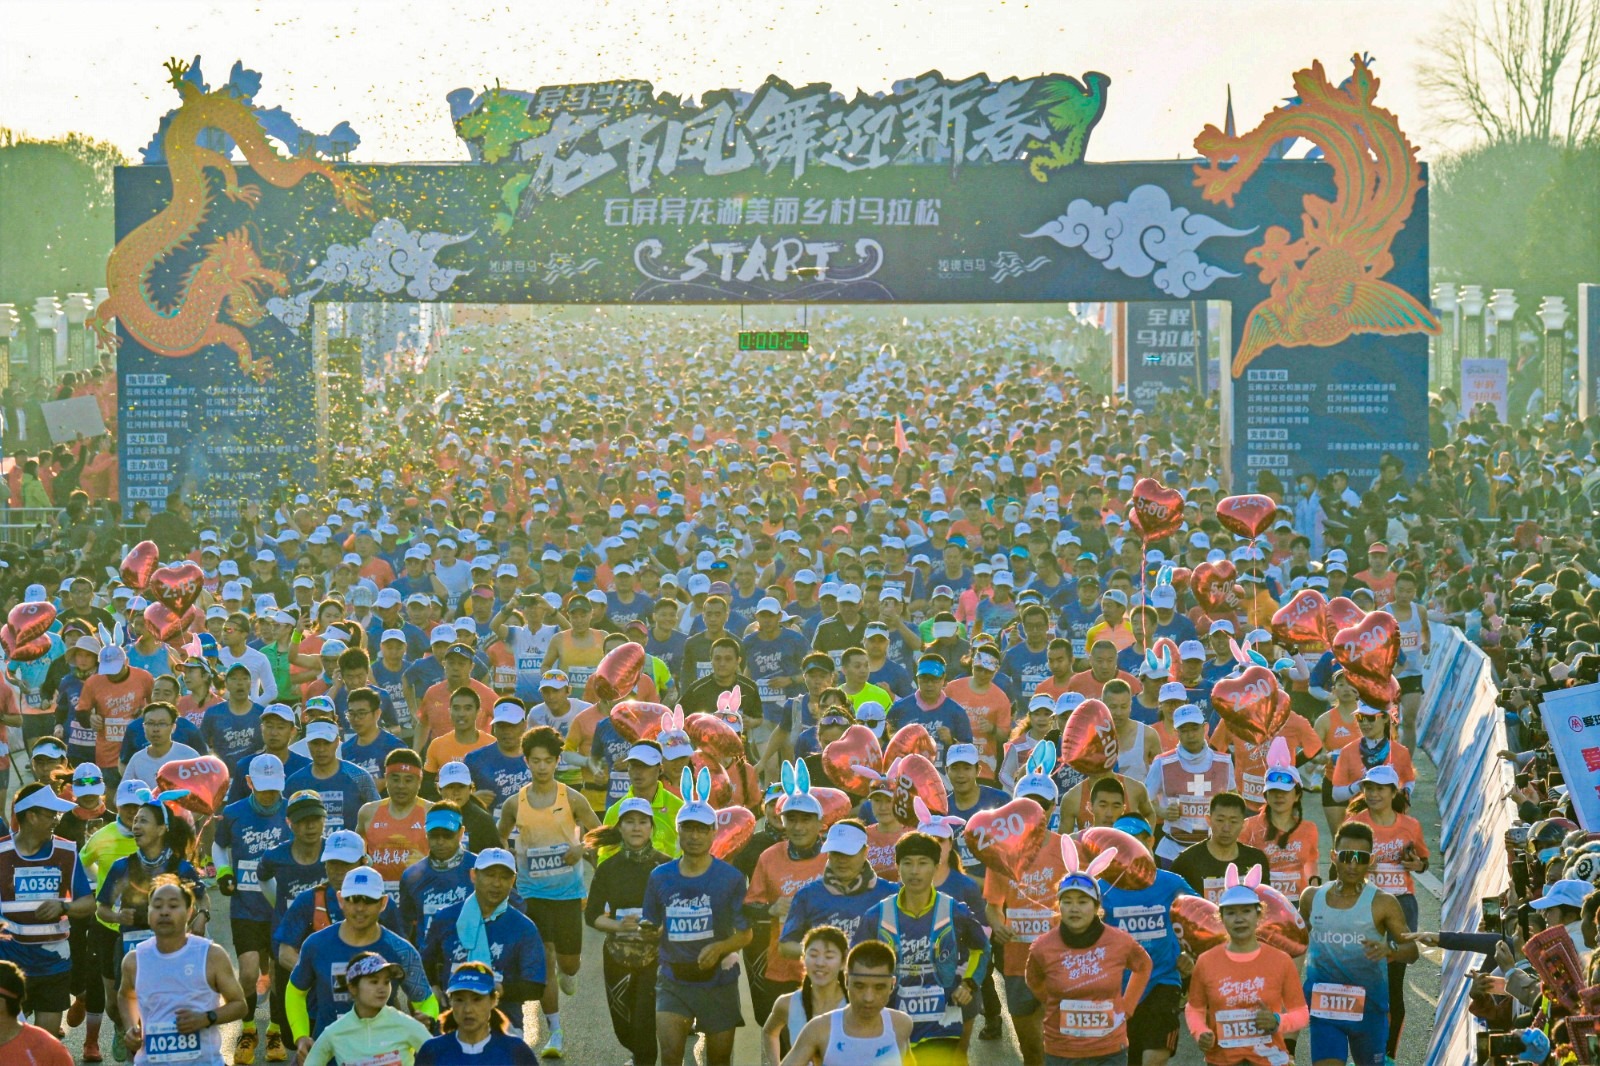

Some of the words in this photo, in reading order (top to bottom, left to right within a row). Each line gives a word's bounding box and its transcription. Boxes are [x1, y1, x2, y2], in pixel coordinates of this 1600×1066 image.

[604, 197, 942, 226] 石屏异龙湖美丽乡村马拉松
[680, 235, 843, 282] START
[1147, 308, 1190, 326] 全程
[740, 332, 808, 349] 0:00:24
[1136, 330, 1202, 347] 马拉松
[1136, 495, 1168, 519] 5:00
[1231, 494, 1269, 511] 2:45
[161, 579, 197, 598] 2:15
[1282, 595, 1318, 629] 2:45
[1344, 625, 1388, 663] 2:30
[521, 659, 542, 669] A016
[1228, 678, 1272, 712] 2:30
[71, 730, 97, 741] A0325
[106, 725, 126, 735] B04
[1095, 719, 1119, 769] 2:00
[178, 759, 222, 780] 6:00
[611, 780, 630, 792] A00
[895, 774, 913, 819] 5:30
[1182, 804, 1211, 816] B082
[973, 813, 1025, 851] 2:30
[530, 854, 567, 871] A040
[18, 877, 60, 892] A0365
[669, 916, 710, 933] A0147
[1011, 919, 1051, 934] B1208
[1118, 914, 1165, 933] A0064
[901, 935, 931, 955] 龙飞凤
[898, 996, 940, 1014] A0117
[1319, 993, 1357, 1012] B1117
[1066, 1011, 1109, 1028] B1352
[149, 1033, 199, 1053] A0288
